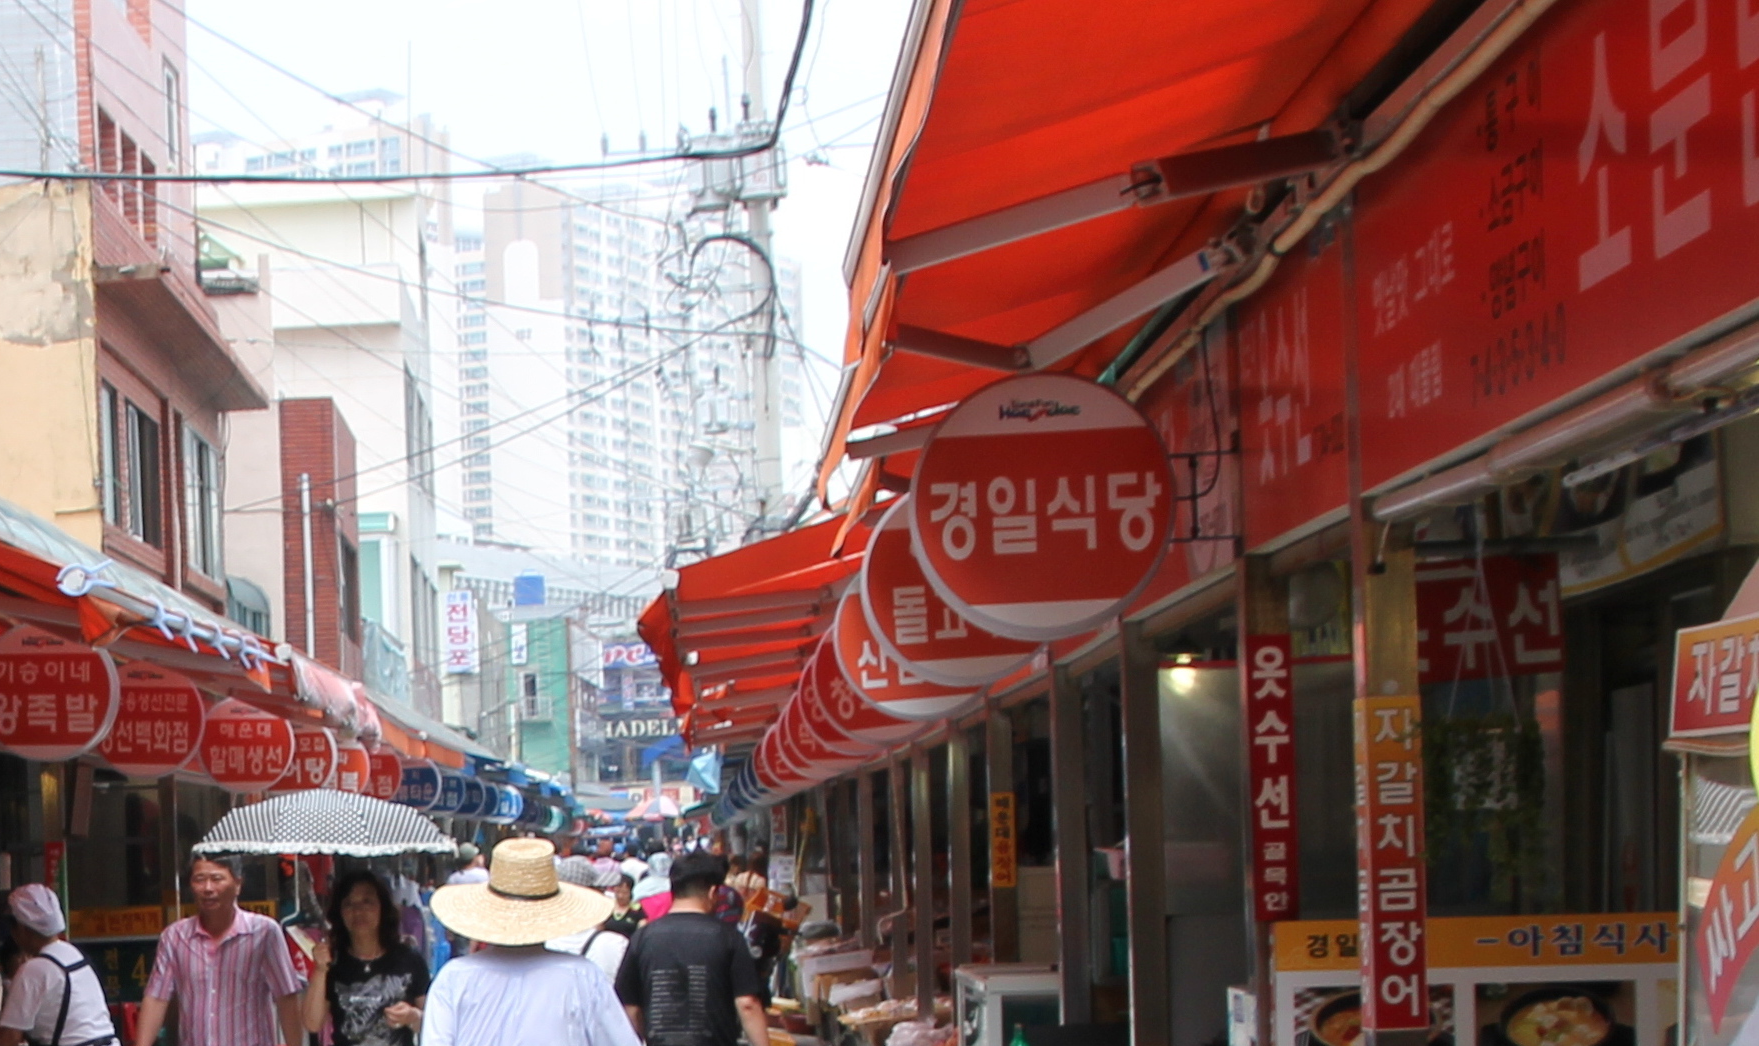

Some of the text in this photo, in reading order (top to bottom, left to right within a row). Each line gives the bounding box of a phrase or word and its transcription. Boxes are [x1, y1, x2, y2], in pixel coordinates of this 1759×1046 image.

[929, 470, 1162, 562] 경일식당
[446, 602, 471, 666] 전당포
[209, 744, 284, 776] 할매생선
[218, 721, 273, 739] 해운대
[1252, 644, 1290, 830] 옷수선
[1374, 707, 1423, 1017] 자갈치곰장어
